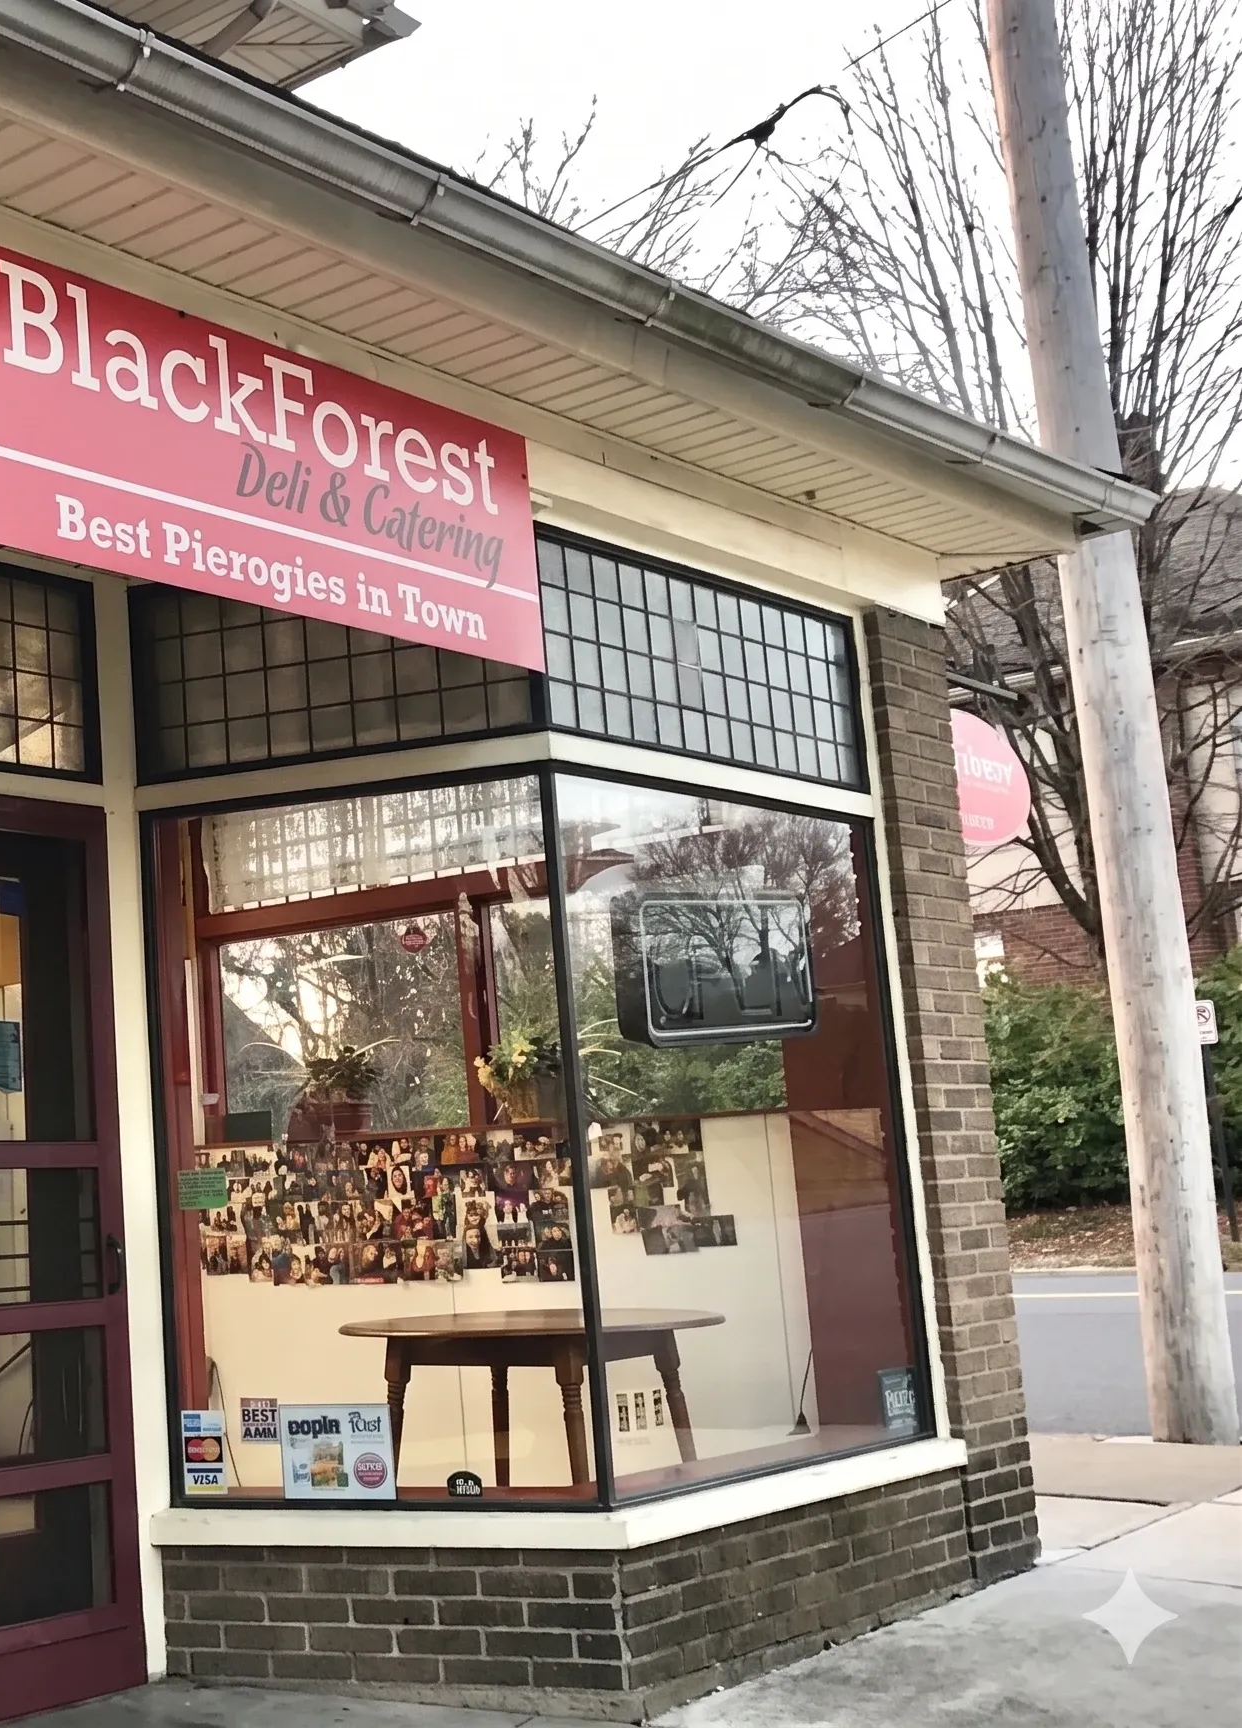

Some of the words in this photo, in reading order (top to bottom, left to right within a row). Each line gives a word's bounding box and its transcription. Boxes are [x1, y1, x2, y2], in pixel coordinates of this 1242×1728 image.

[0, 258, 500, 515] BlackForest
[55, 494, 152, 559] Best
[162, 521, 347, 605] Pierogies
[356, 572, 392, 617] in
[397, 582, 488, 642] Town
[236, 441, 312, 514] Deli
[319, 471, 351, 527] &
[363, 484, 504, 589] Catering
[241, 1408, 278, 1423] BEST
